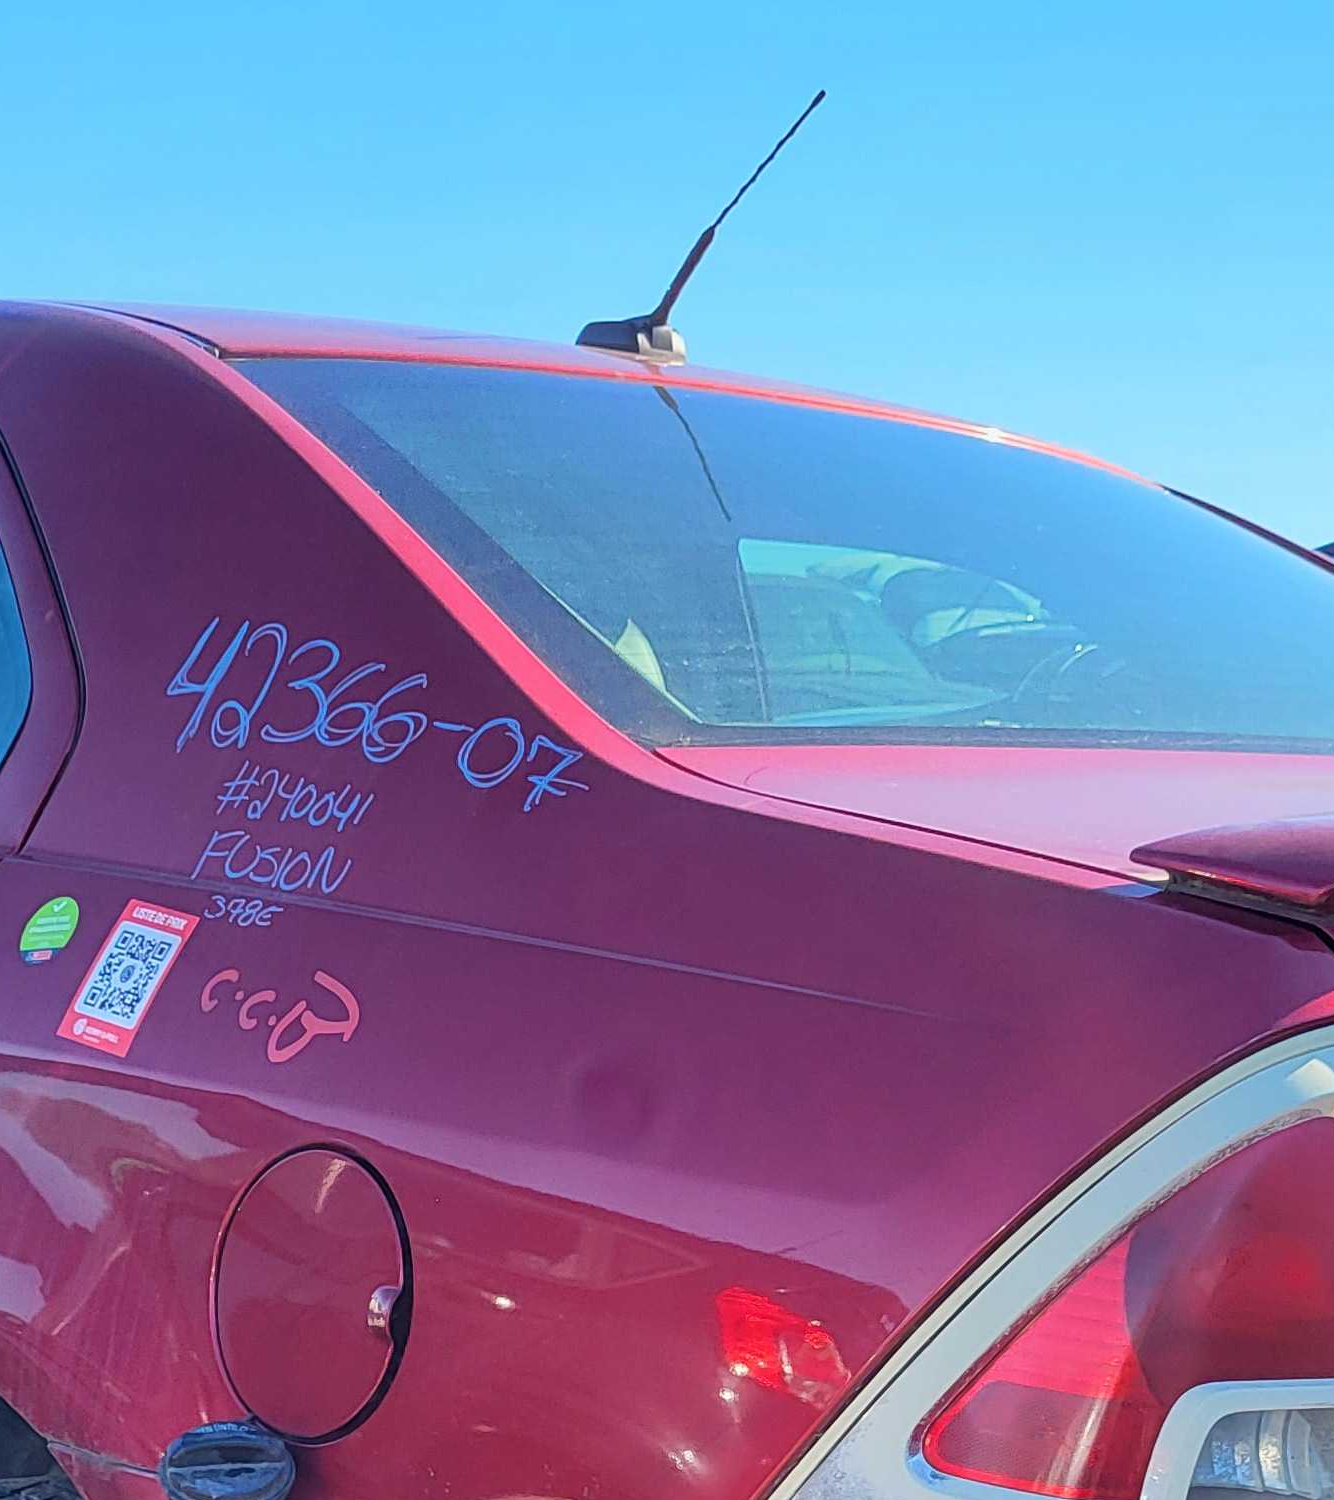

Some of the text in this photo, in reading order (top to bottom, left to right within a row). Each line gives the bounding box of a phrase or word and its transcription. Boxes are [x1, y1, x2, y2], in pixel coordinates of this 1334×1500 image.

[167, 616, 589, 811] 42366-07
[217, 760, 374, 832] #240041
[191, 831, 352, 895] FUSION
